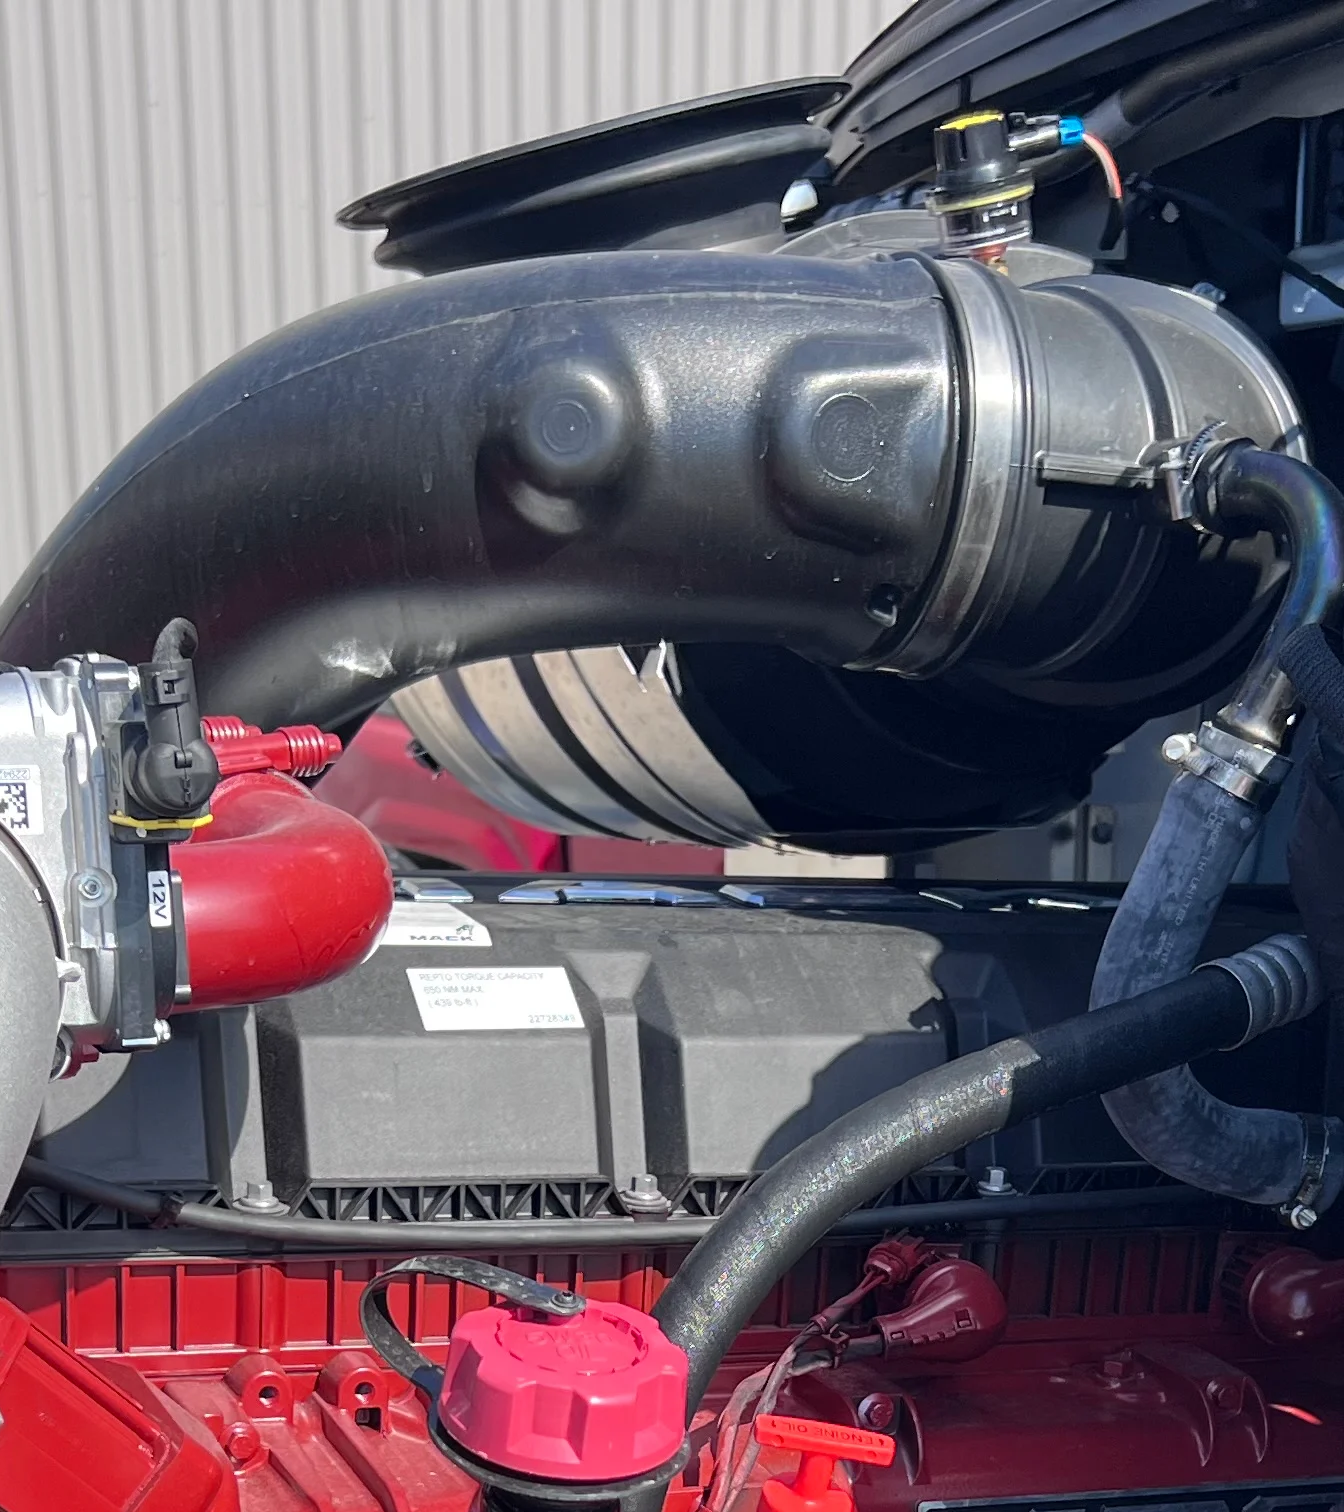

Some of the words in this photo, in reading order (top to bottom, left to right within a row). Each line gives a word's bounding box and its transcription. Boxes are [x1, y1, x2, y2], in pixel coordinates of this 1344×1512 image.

[152, 879, 167, 920] 12V
[455, 972, 495, 981] TORQUE
[497, 972, 545, 981] CAPACITY
[783, 1422, 808, 1433] OIL
[814, 1428, 874, 1445] ENGINE
